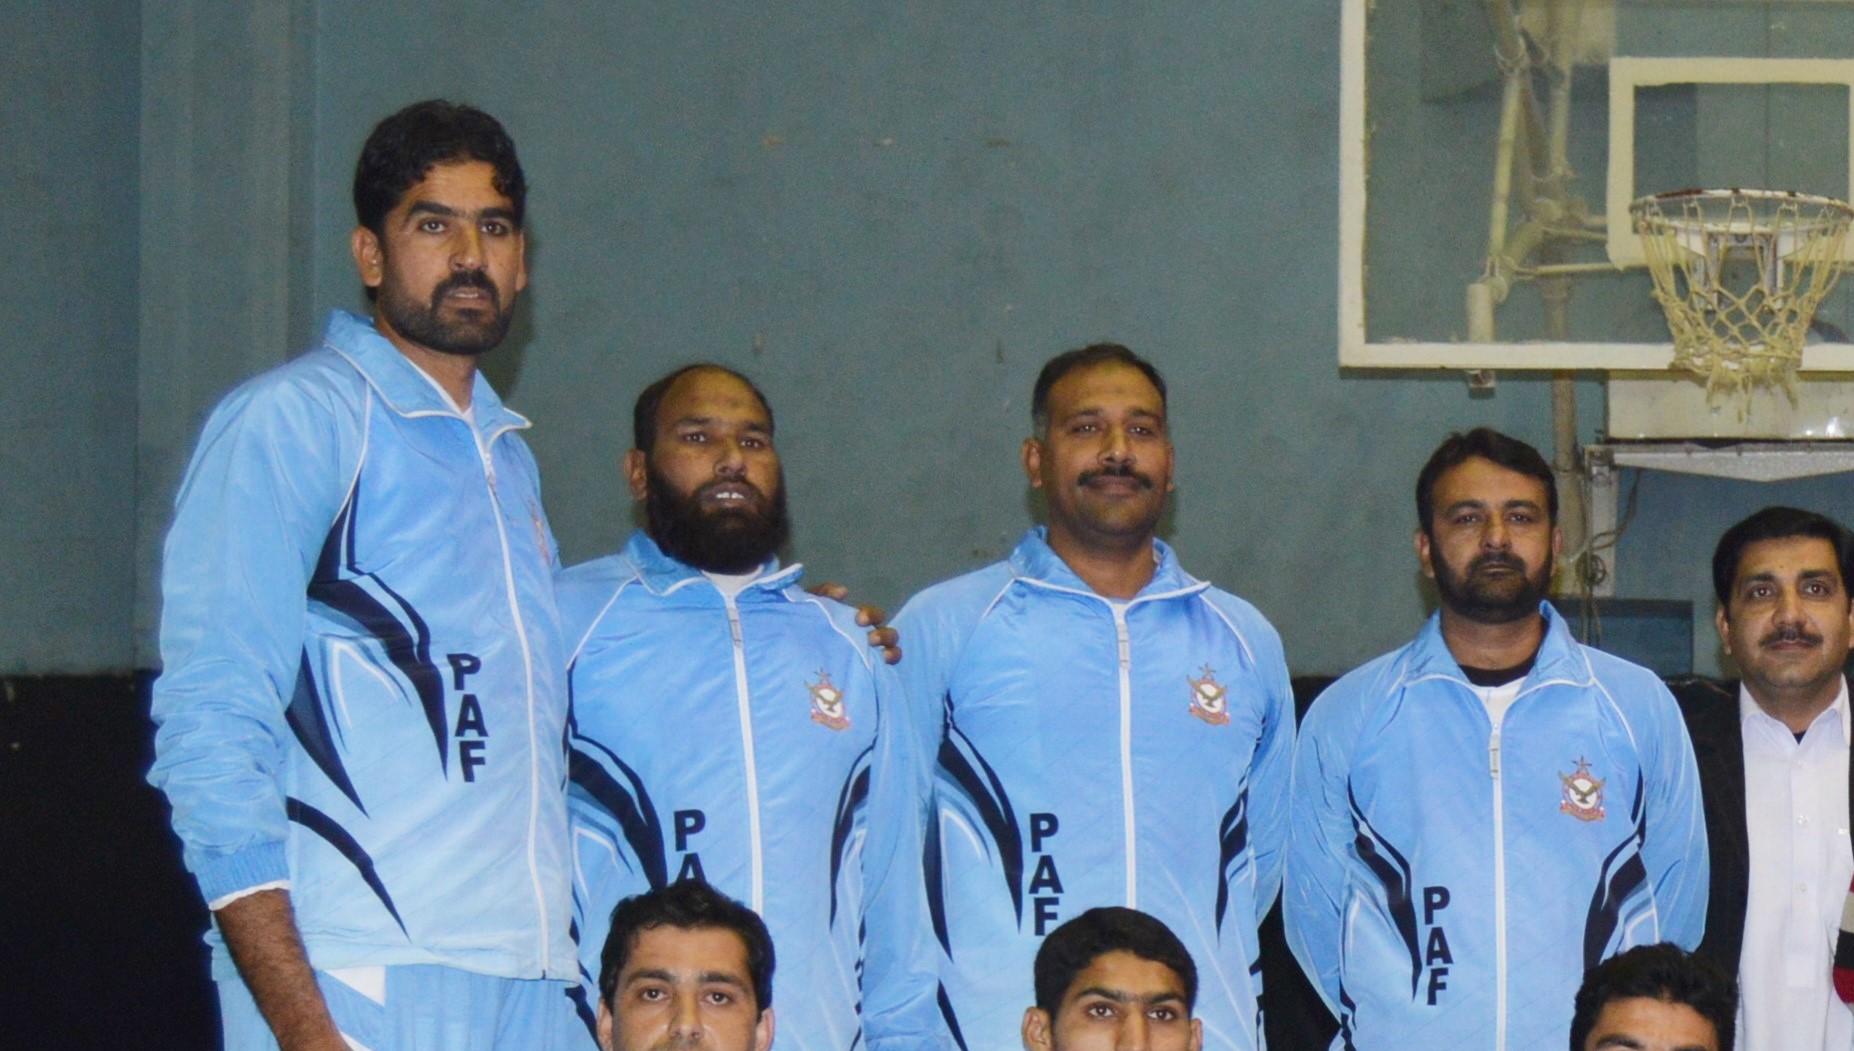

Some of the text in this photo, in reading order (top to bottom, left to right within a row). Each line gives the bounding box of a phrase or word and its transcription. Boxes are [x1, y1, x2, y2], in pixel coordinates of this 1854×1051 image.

[448, 653, 488, 783] PAF
[1028, 812, 1065, 937] PAF
[1423, 885, 1454, 1006] PAF
